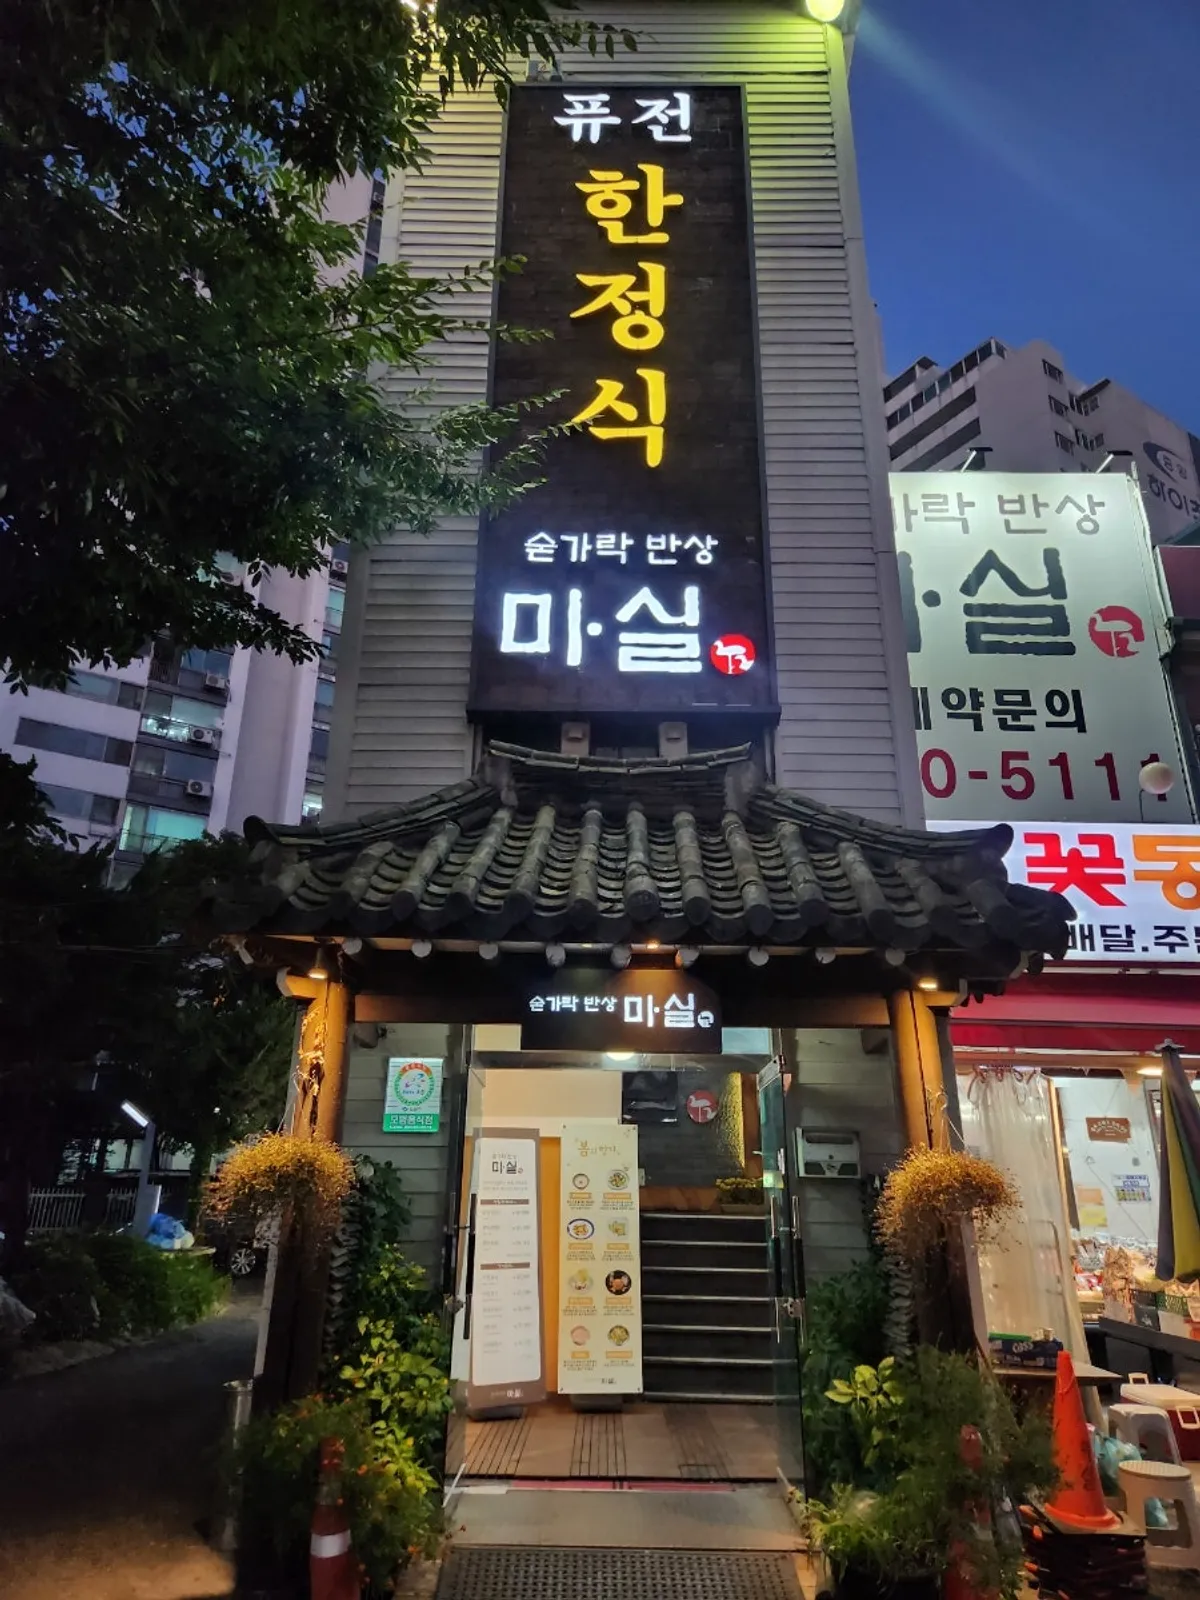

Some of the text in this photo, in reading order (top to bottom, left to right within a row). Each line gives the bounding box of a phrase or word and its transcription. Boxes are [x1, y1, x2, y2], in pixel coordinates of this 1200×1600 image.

[553, 91, 693, 144] 퓨전
[568, 162, 684, 469] 한정식
[997, 494, 1105, 535] 반상
[645, 533, 719, 565] 반상
[584, 996, 617, 1012] 반상
